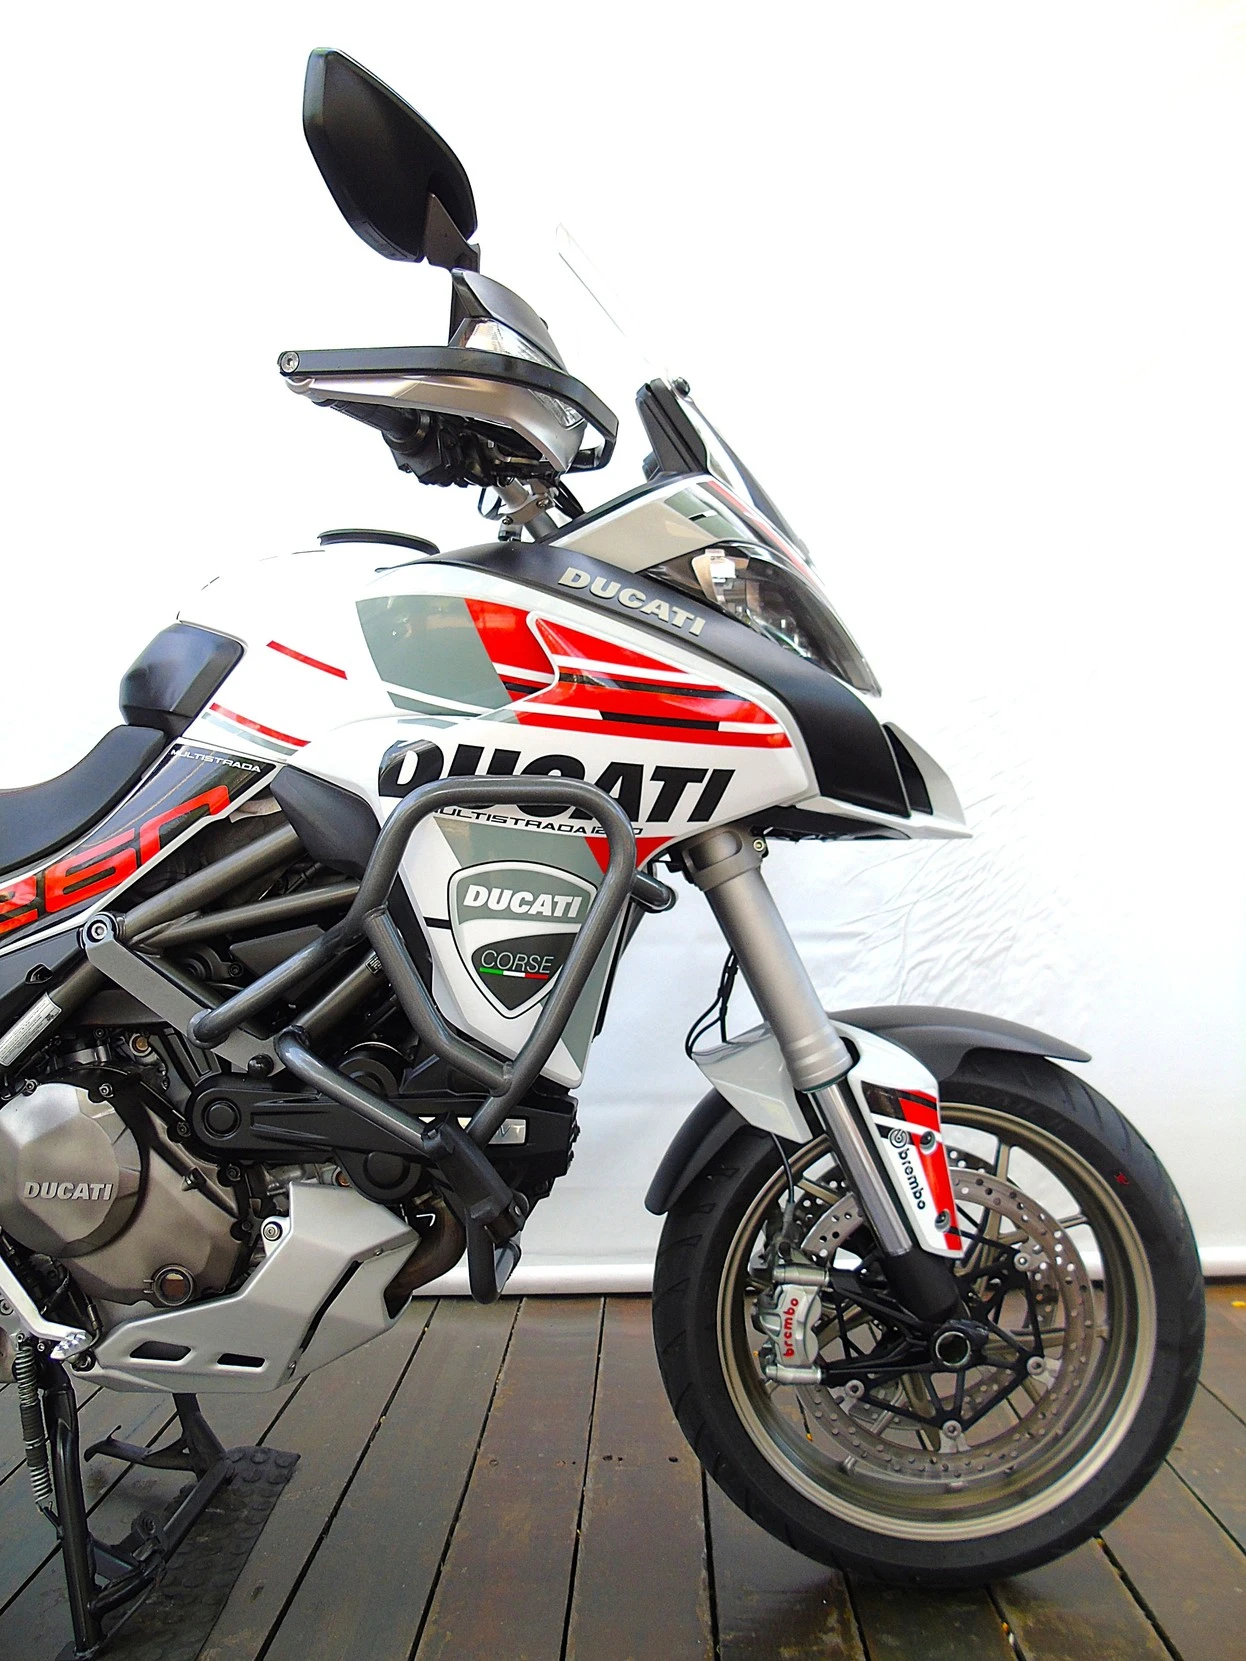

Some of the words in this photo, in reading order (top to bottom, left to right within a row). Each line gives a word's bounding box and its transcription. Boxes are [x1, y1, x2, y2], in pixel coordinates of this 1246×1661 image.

[558, 567, 705, 636] DUCATI
[170, 749, 261, 773] MULTISTRADA
[434, 806, 587, 835] ULTISTRADA
[591, 825, 644, 835] 120
[463, 884, 583, 918] DUCATI
[481, 949, 554, 974] CORSE
[24, 1181, 114, 1201] DUCATI
[898, 1147, 926, 1210] brembo
[783, 1298, 799, 1358] brembo
